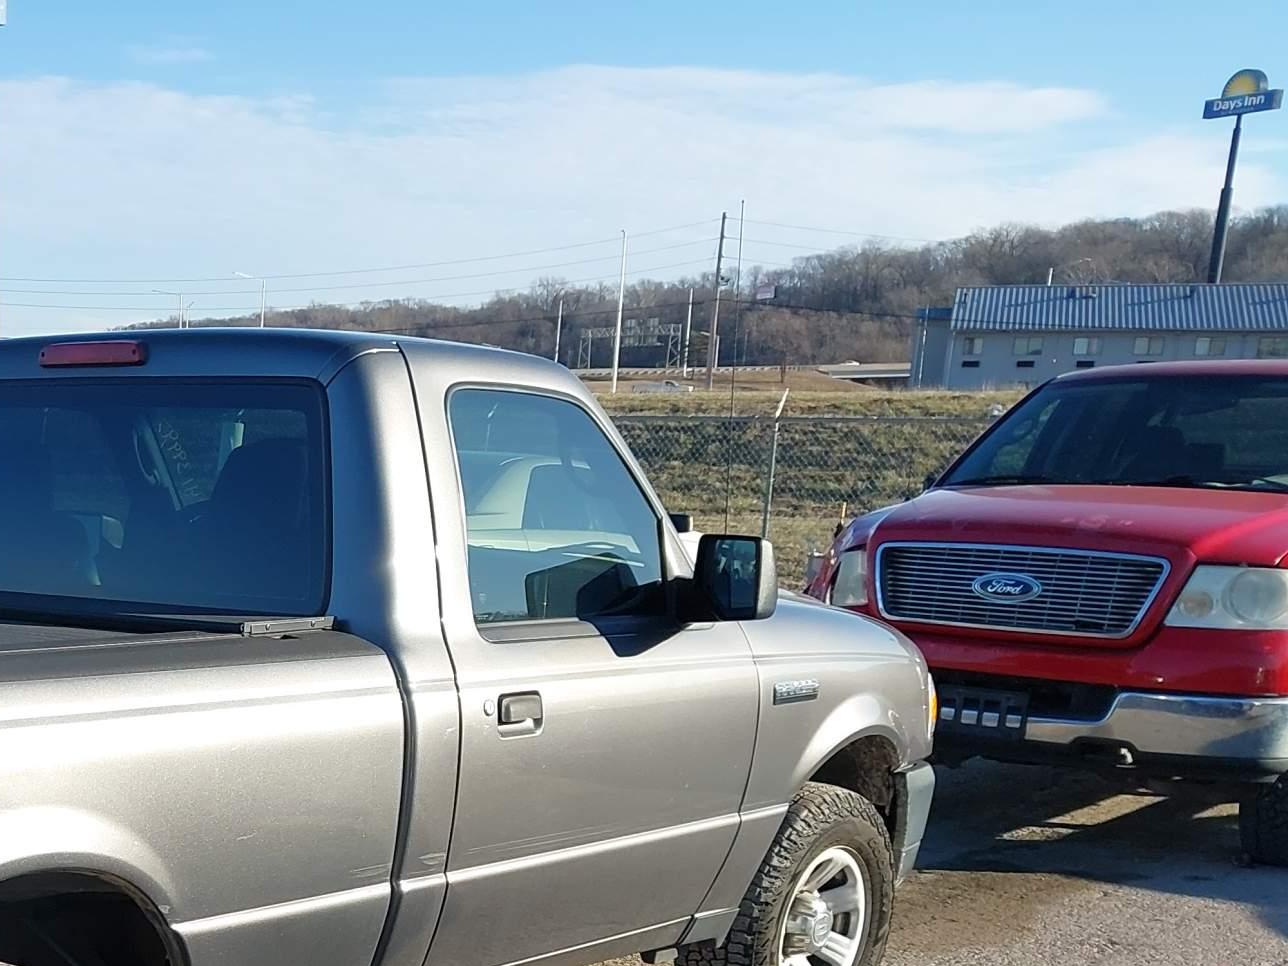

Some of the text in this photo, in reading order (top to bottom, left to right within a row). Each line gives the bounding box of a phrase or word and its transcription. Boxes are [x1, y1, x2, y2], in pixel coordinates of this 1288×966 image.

[1213, 98, 1244, 112] Days
[1244, 94, 1265, 106] Inn
[986, 578, 1025, 596] Ford
